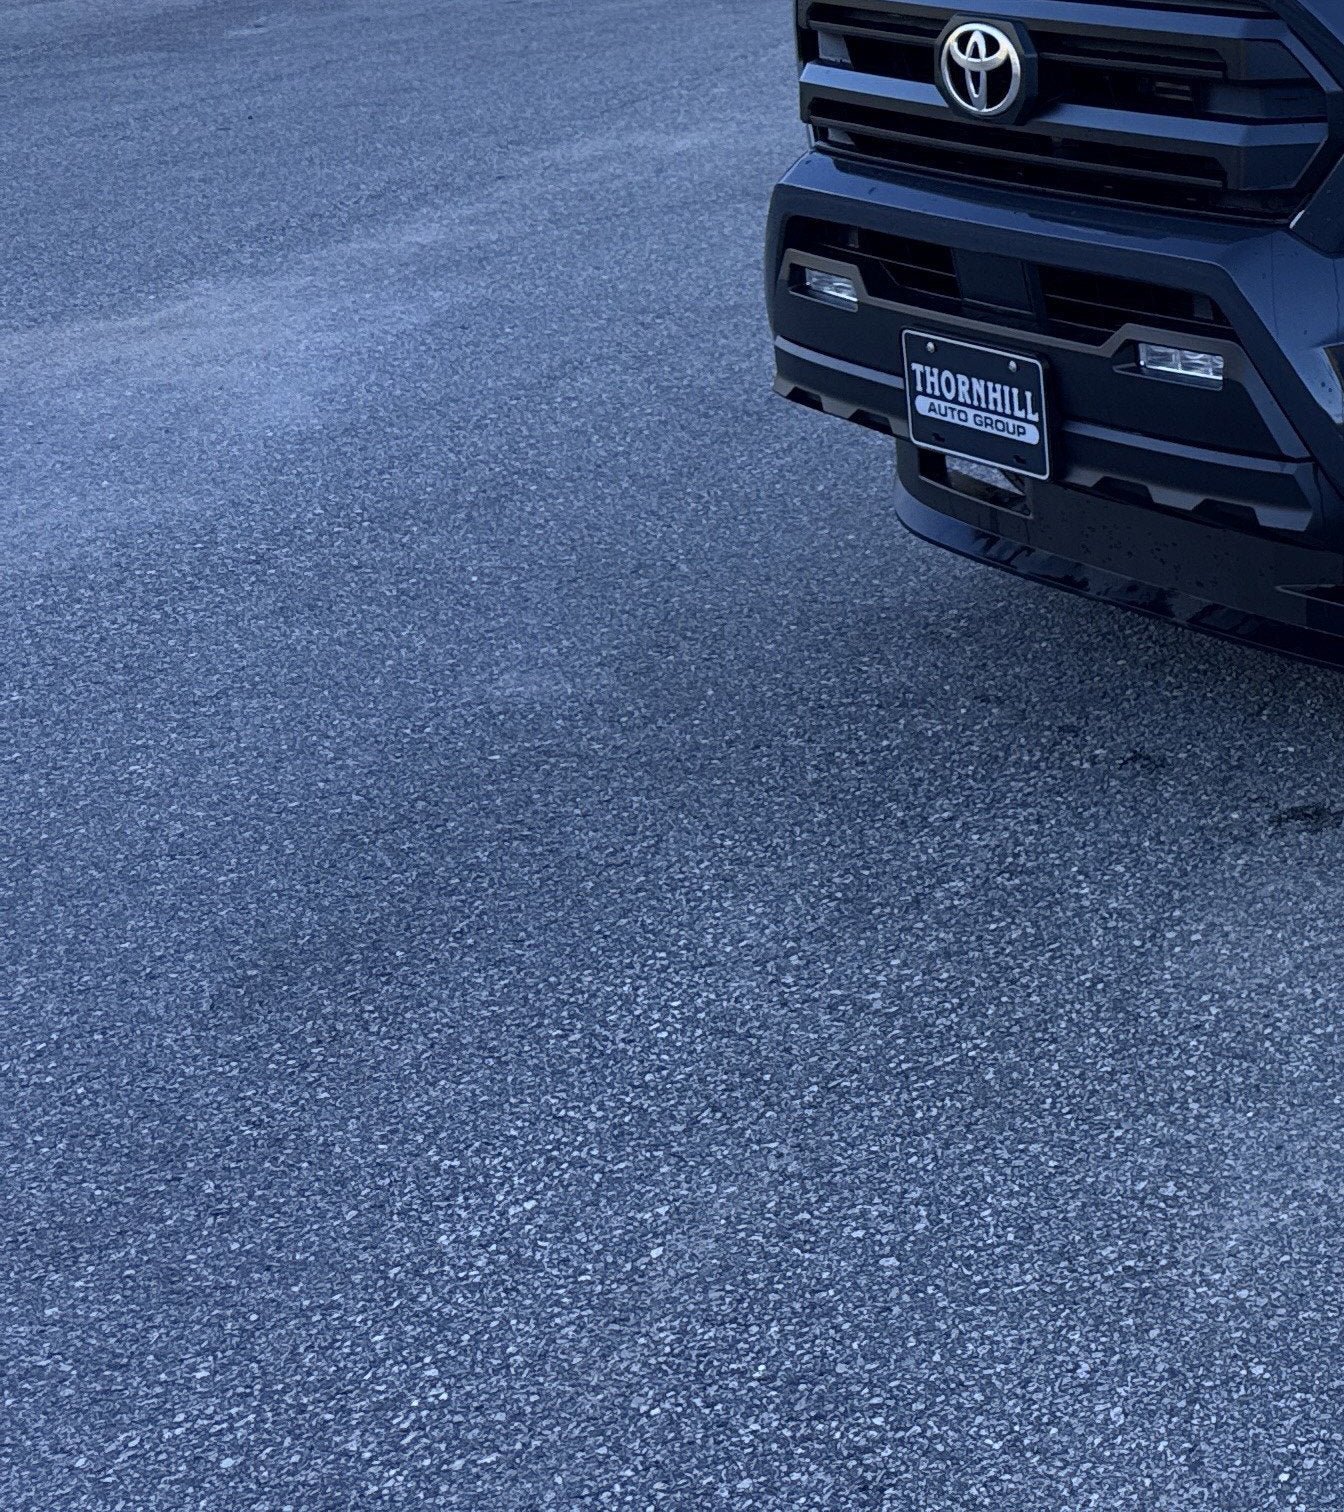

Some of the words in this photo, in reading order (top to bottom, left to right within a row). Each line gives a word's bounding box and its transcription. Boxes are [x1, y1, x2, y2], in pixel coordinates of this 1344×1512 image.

[911, 362, 1040, 423] THORNHILL
[927, 401, 968, 423] AUTO
[973, 413, 1027, 438] GROUP
